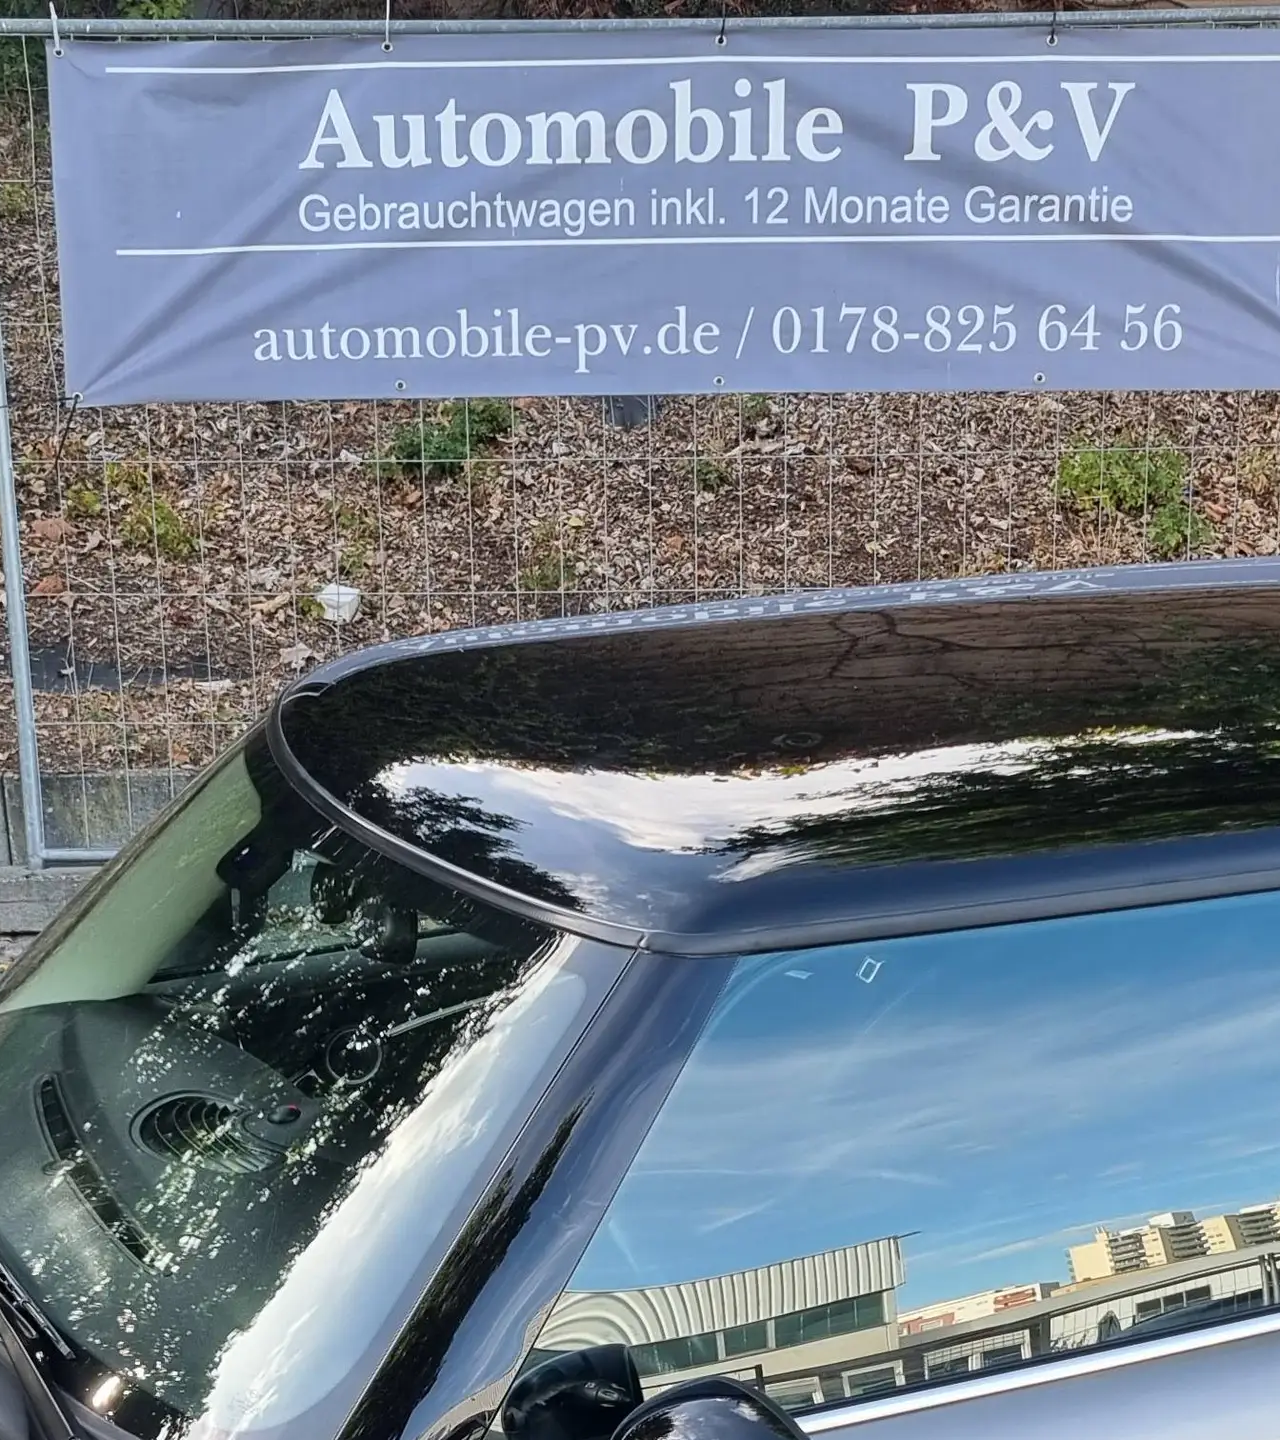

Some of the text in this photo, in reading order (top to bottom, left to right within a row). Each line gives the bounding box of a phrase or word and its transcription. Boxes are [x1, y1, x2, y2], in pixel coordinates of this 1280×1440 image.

[298, 78, 1136, 169] Automobile P&V
[298, 185, 1134, 237] Gebrauchtwagen inkl. 12 Monate Garantie
[253, 302, 1184, 374] automobile-pv.de / 0178-825 64 56
